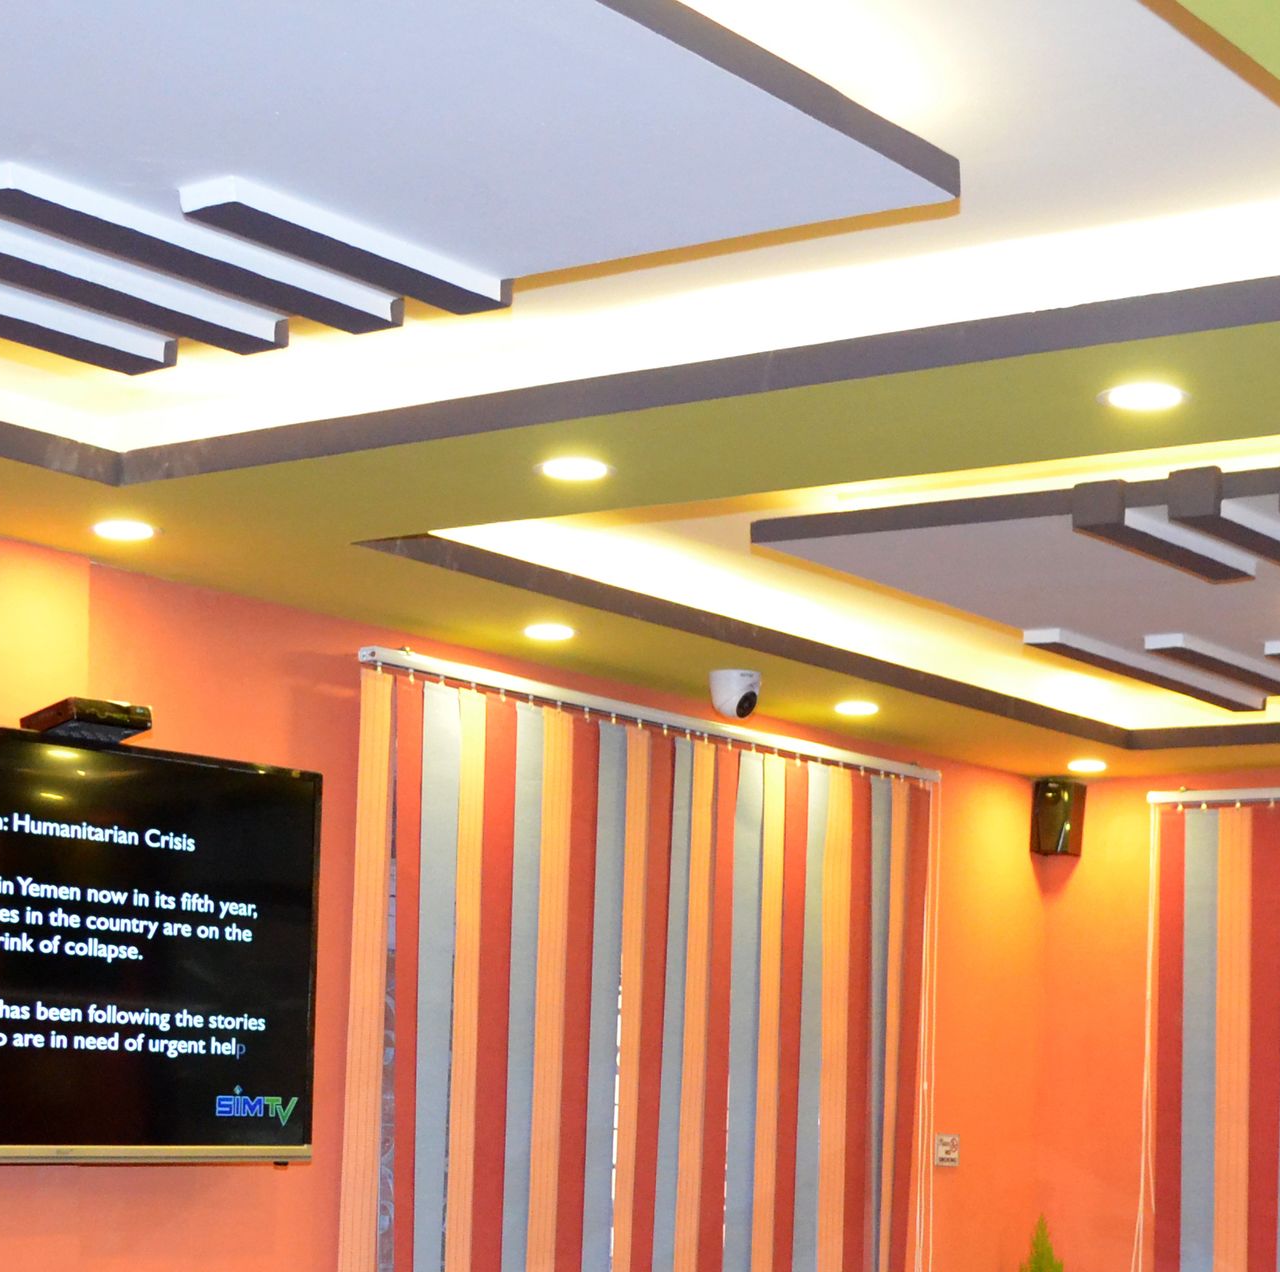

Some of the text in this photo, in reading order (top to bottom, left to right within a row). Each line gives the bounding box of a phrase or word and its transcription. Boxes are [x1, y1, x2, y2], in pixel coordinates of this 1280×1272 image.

[12, 812, 140, 846] Humanitarian
[144, 828, 196, 852] Crisis
[16, 875, 82, 902] Yemen
[86, 888, 129, 905] now
[132, 888, 150, 908] in
[154, 890, 177, 910] its
[180, 891, 215, 914] fifth
[218, 900, 259, 920] year,
[25, 906, 44, 926] in
[48, 907, 82, 929] the
[85, 915, 160, 940] country
[162, 921, 193, 938] are
[196, 925, 220, 940] on
[224, 922, 253, 943] the
[38, 934, 62, 955] of
[64, 937, 144, 964] collapse.
[35, 1000, 83, 1023] been
[87, 1003, 171, 1032] following
[174, 1008, 205, 1029] the
[208, 1013, 266, 1032] stories
[12, 1032, 46, 1049] are
[49, 1030, 68, 1049] in
[73, 1031, 120, 1051] need
[123, 1032, 146, 1052] of
[148, 1038, 207, 1059] urgent
